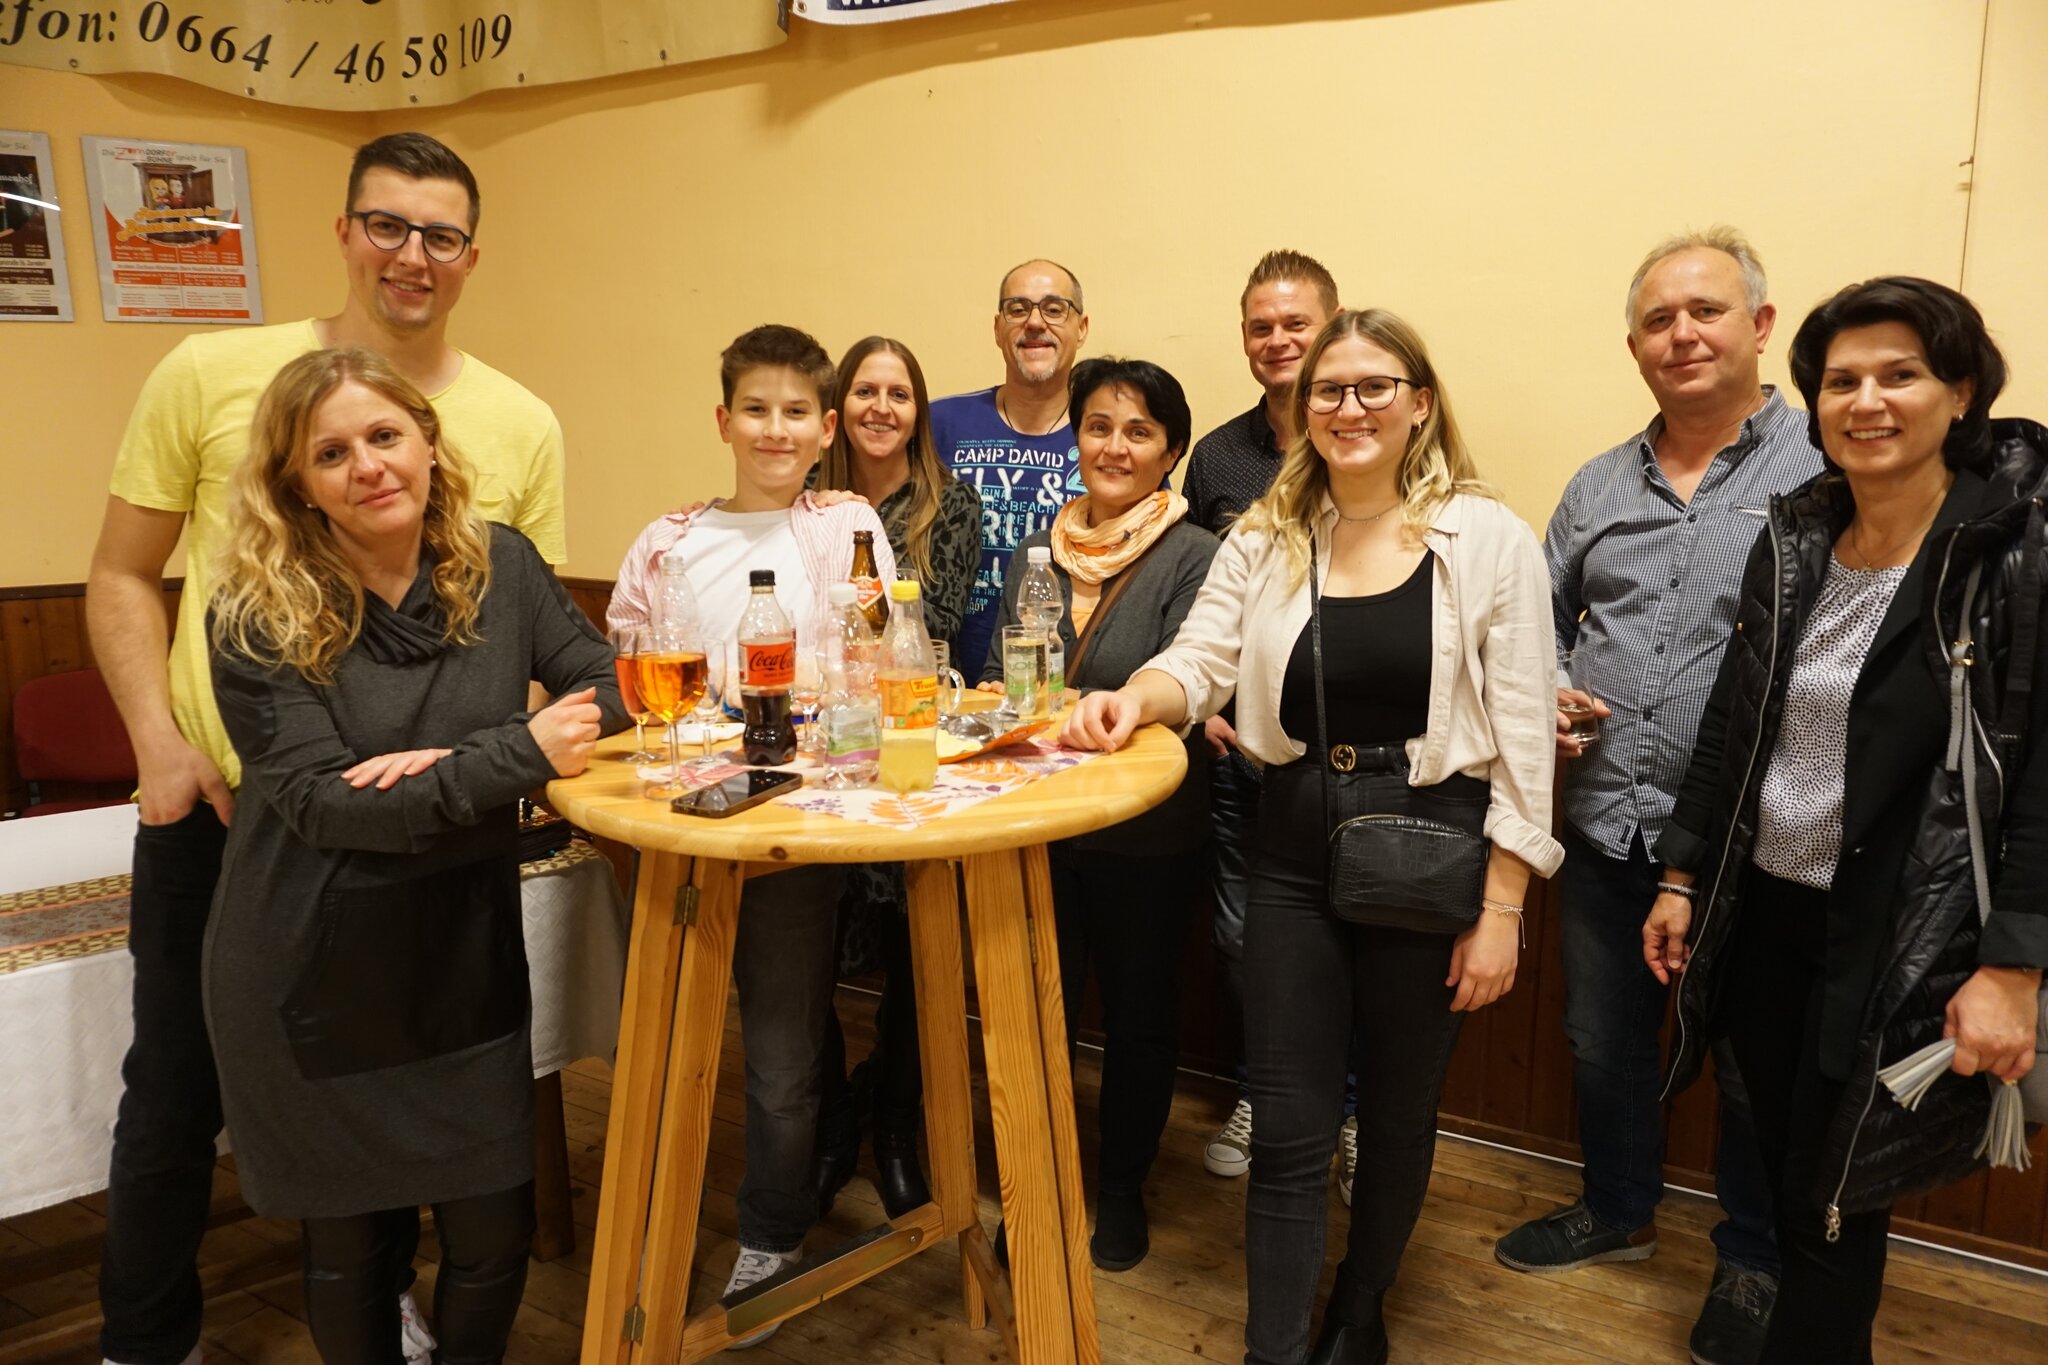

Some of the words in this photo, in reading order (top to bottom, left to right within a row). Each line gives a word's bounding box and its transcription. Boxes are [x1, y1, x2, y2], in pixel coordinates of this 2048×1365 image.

[0, 0, 117, 46] fon:
[139, 1, 273, 72] 0664
[290, 41, 320, 78] /
[333, 40, 386, 83] 46
[401, 33, 447, 79] 58
[458, 14, 512, 69] 109
[954, 448, 1005, 463] CAMP
[1008, 448, 1064, 468] DAVID
